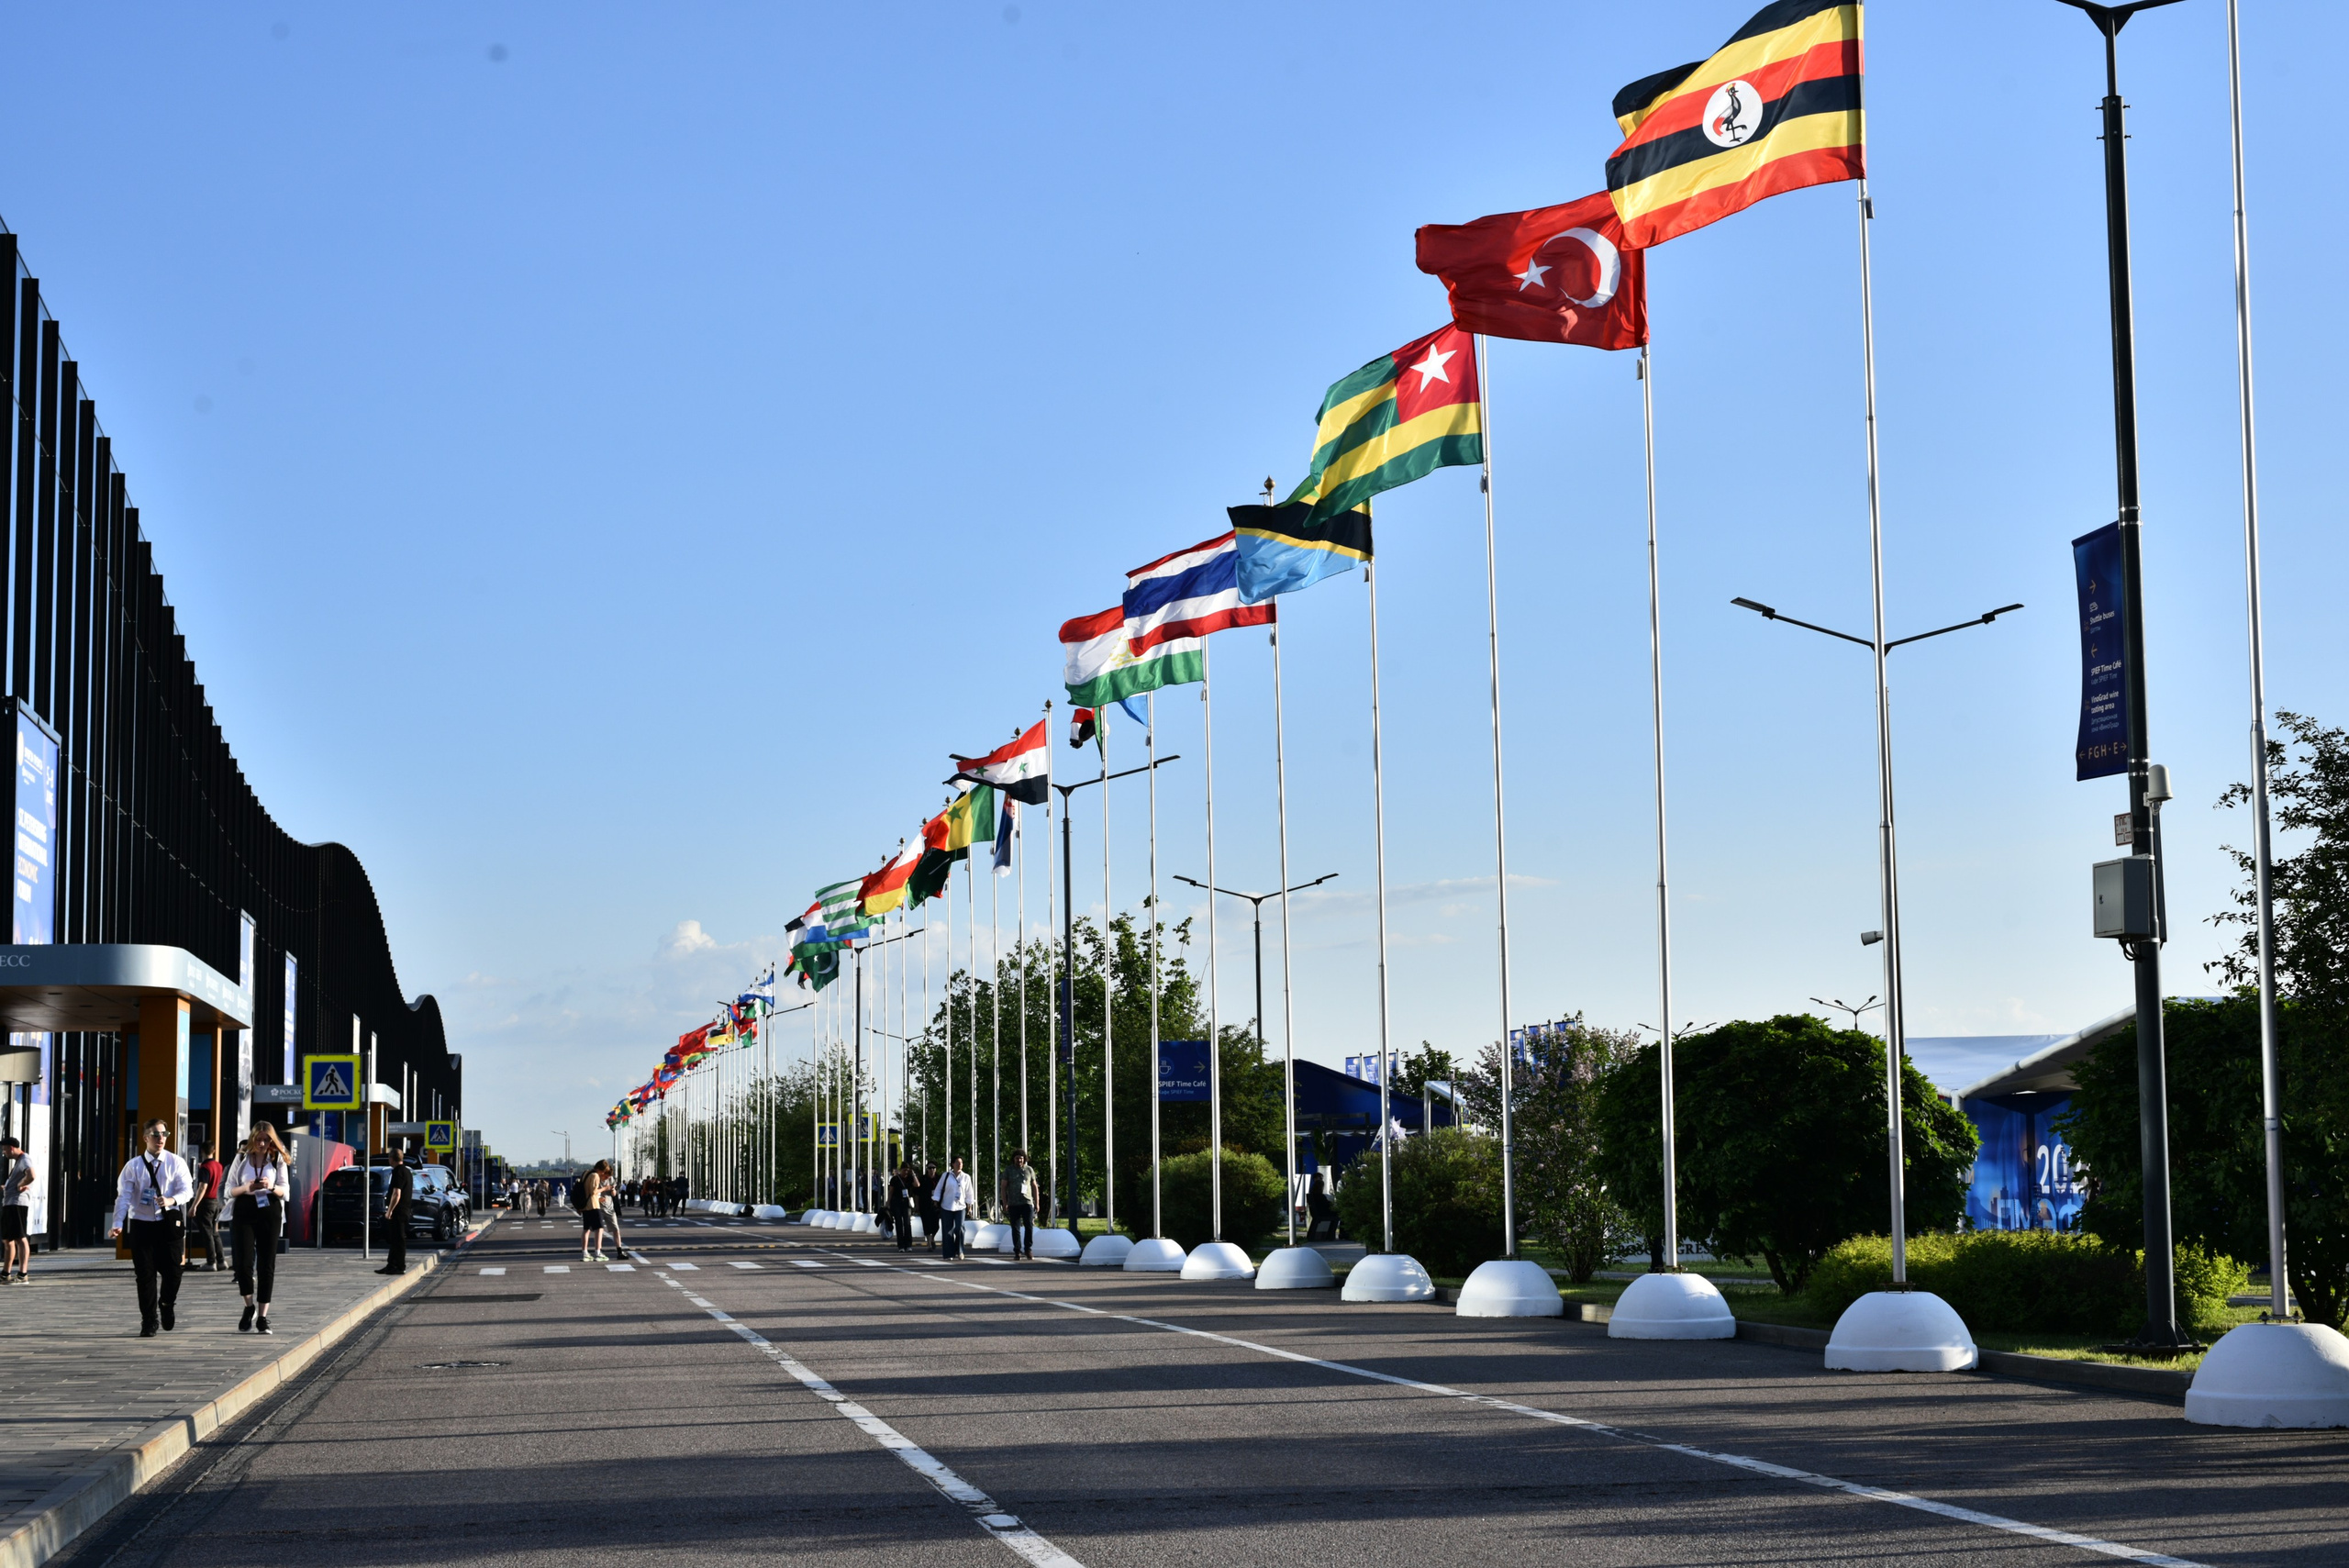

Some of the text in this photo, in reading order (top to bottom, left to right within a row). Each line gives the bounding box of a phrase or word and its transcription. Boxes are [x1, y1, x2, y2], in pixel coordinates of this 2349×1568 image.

[2102, 610, 2115, 620] buses
[2100, 664, 2112, 673] Time
[2104, 702, 2115, 710] area
